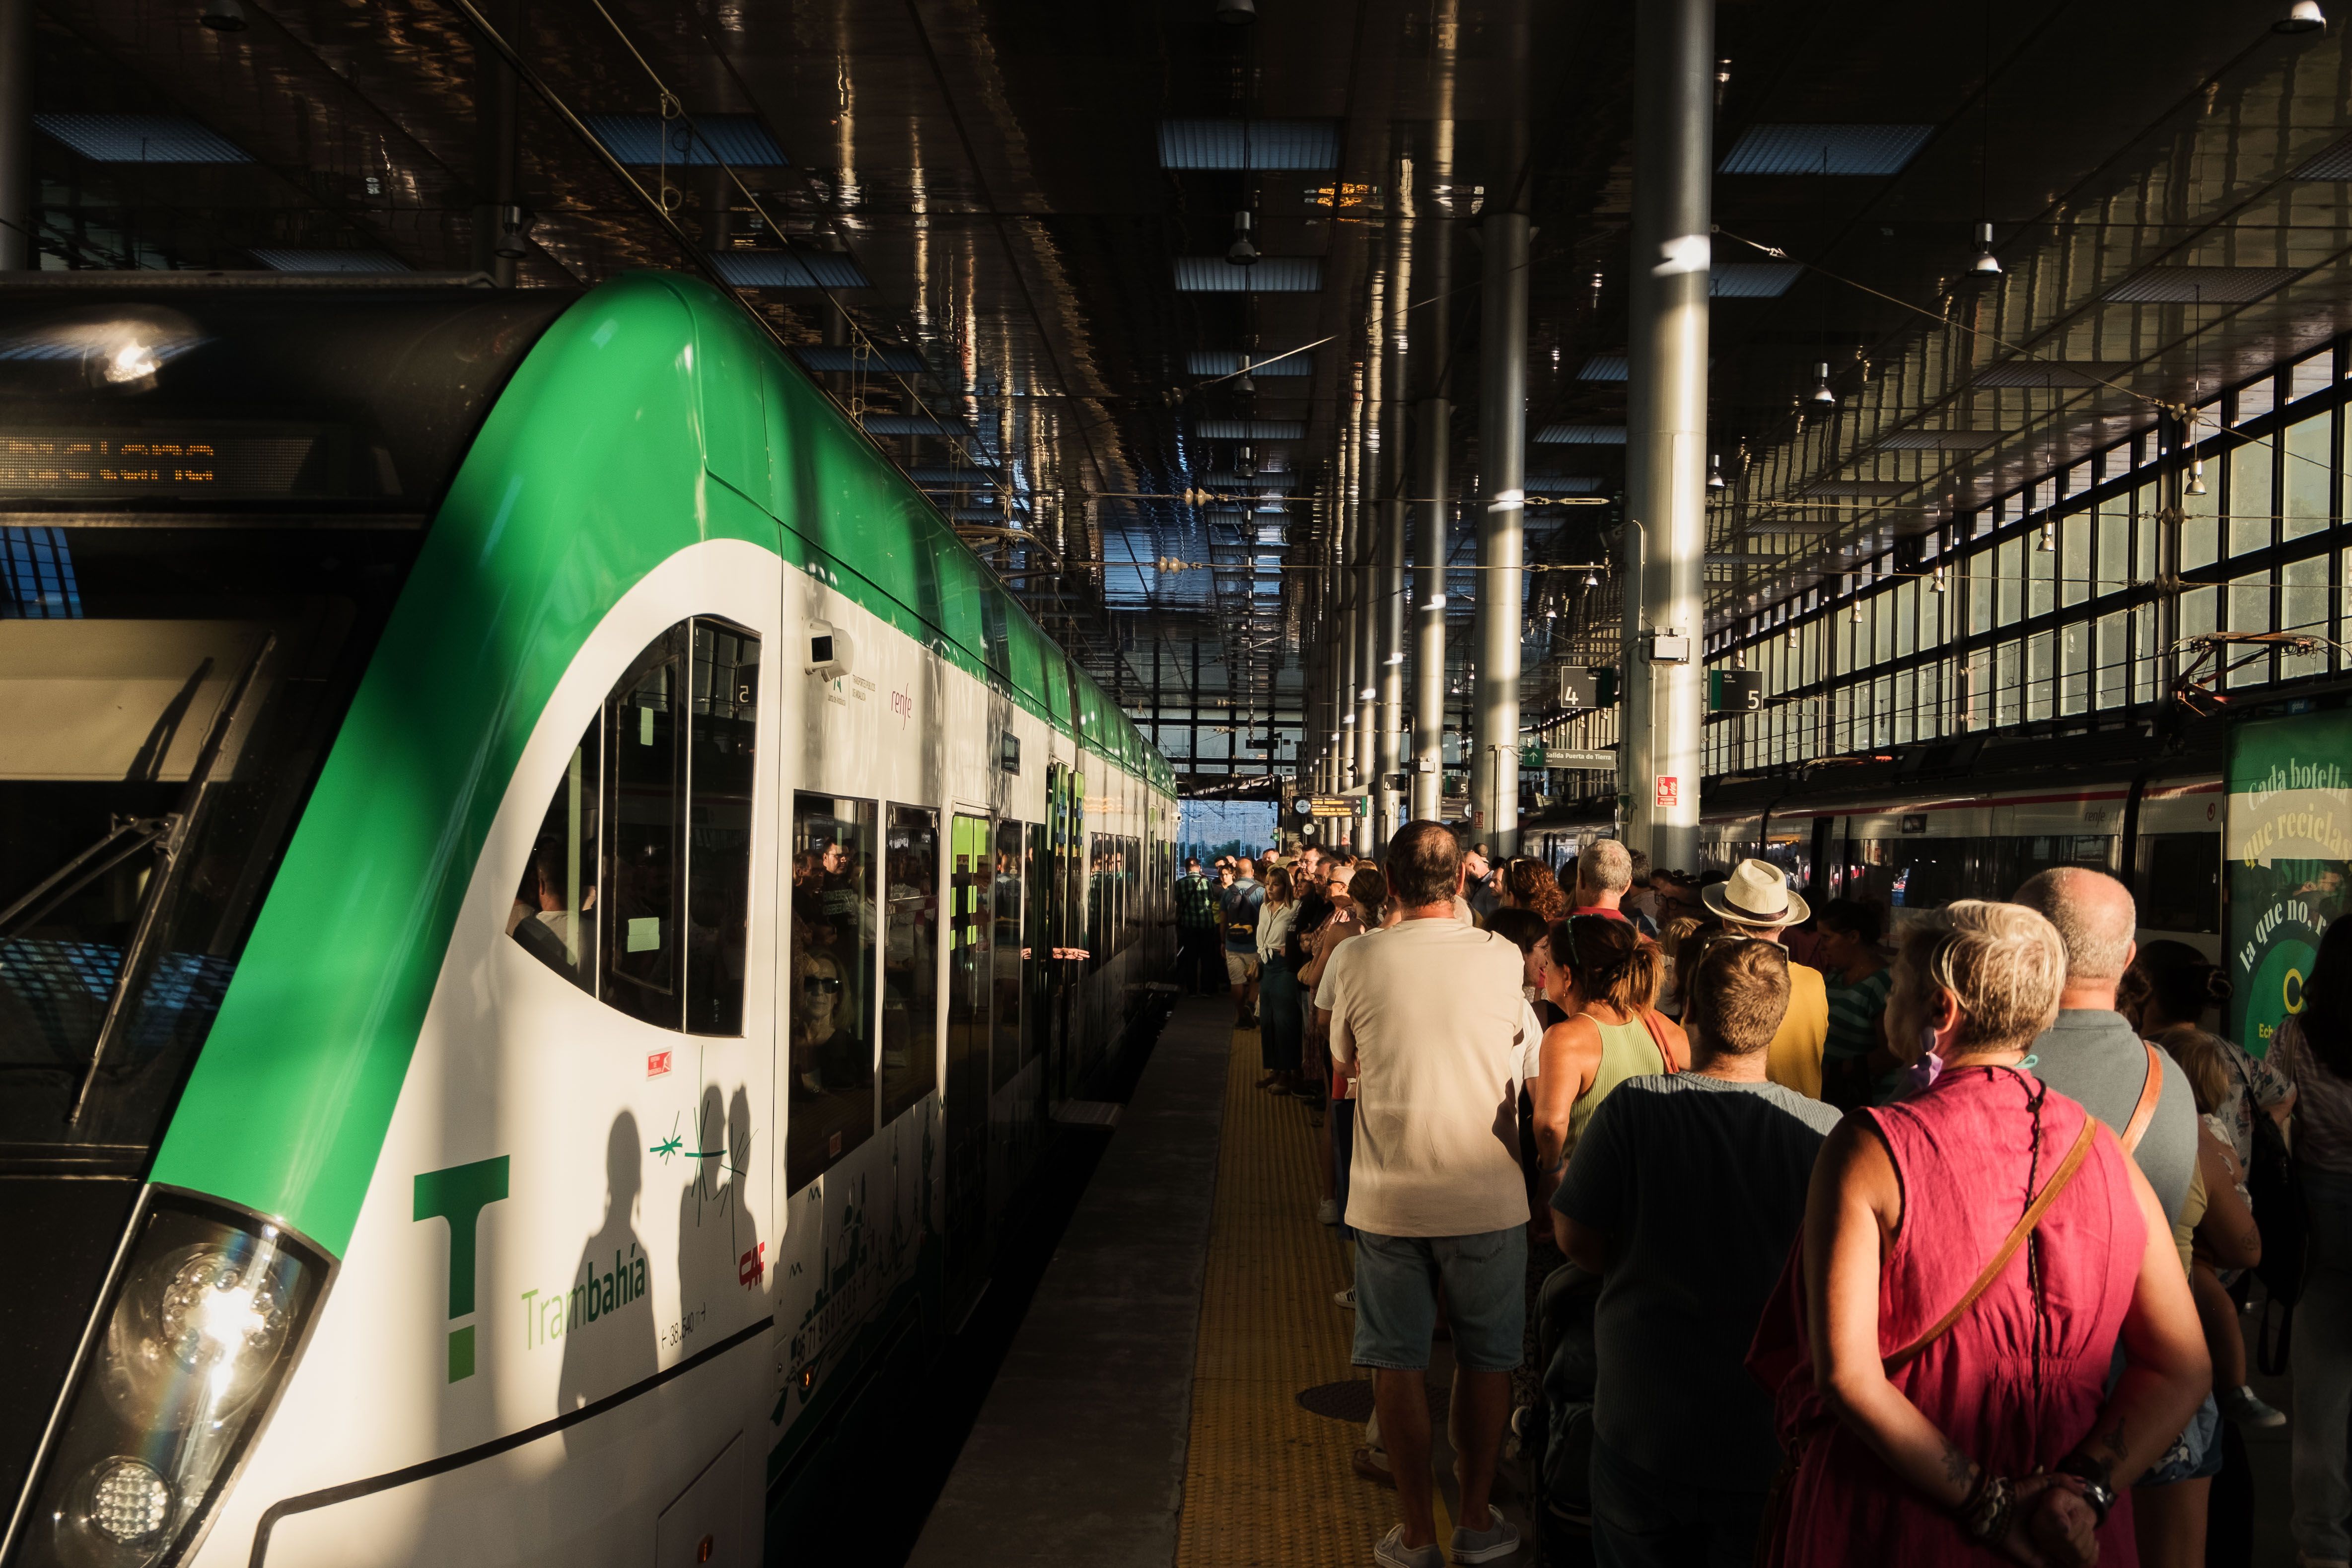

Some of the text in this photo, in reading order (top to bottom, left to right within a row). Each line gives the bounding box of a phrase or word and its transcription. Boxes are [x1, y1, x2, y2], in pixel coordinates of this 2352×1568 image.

[891, 683, 912, 731] renfe
[1565, 686, 1579, 705] 4
[1748, 690, 1759, 710] 5
[1384, 782, 1391, 790] 4
[2248, 758, 2349, 810] Cada botella
[2084, 806, 2106, 827] renfe
[2243, 821, 2273, 870] que
[2239, 941, 2256, 974] la
[2256, 900, 2283, 946] que
[2287, 899, 2312, 931] no,
[739, 1241, 765, 1291] CAF
[521, 1242, 645, 1351] Trambahía
